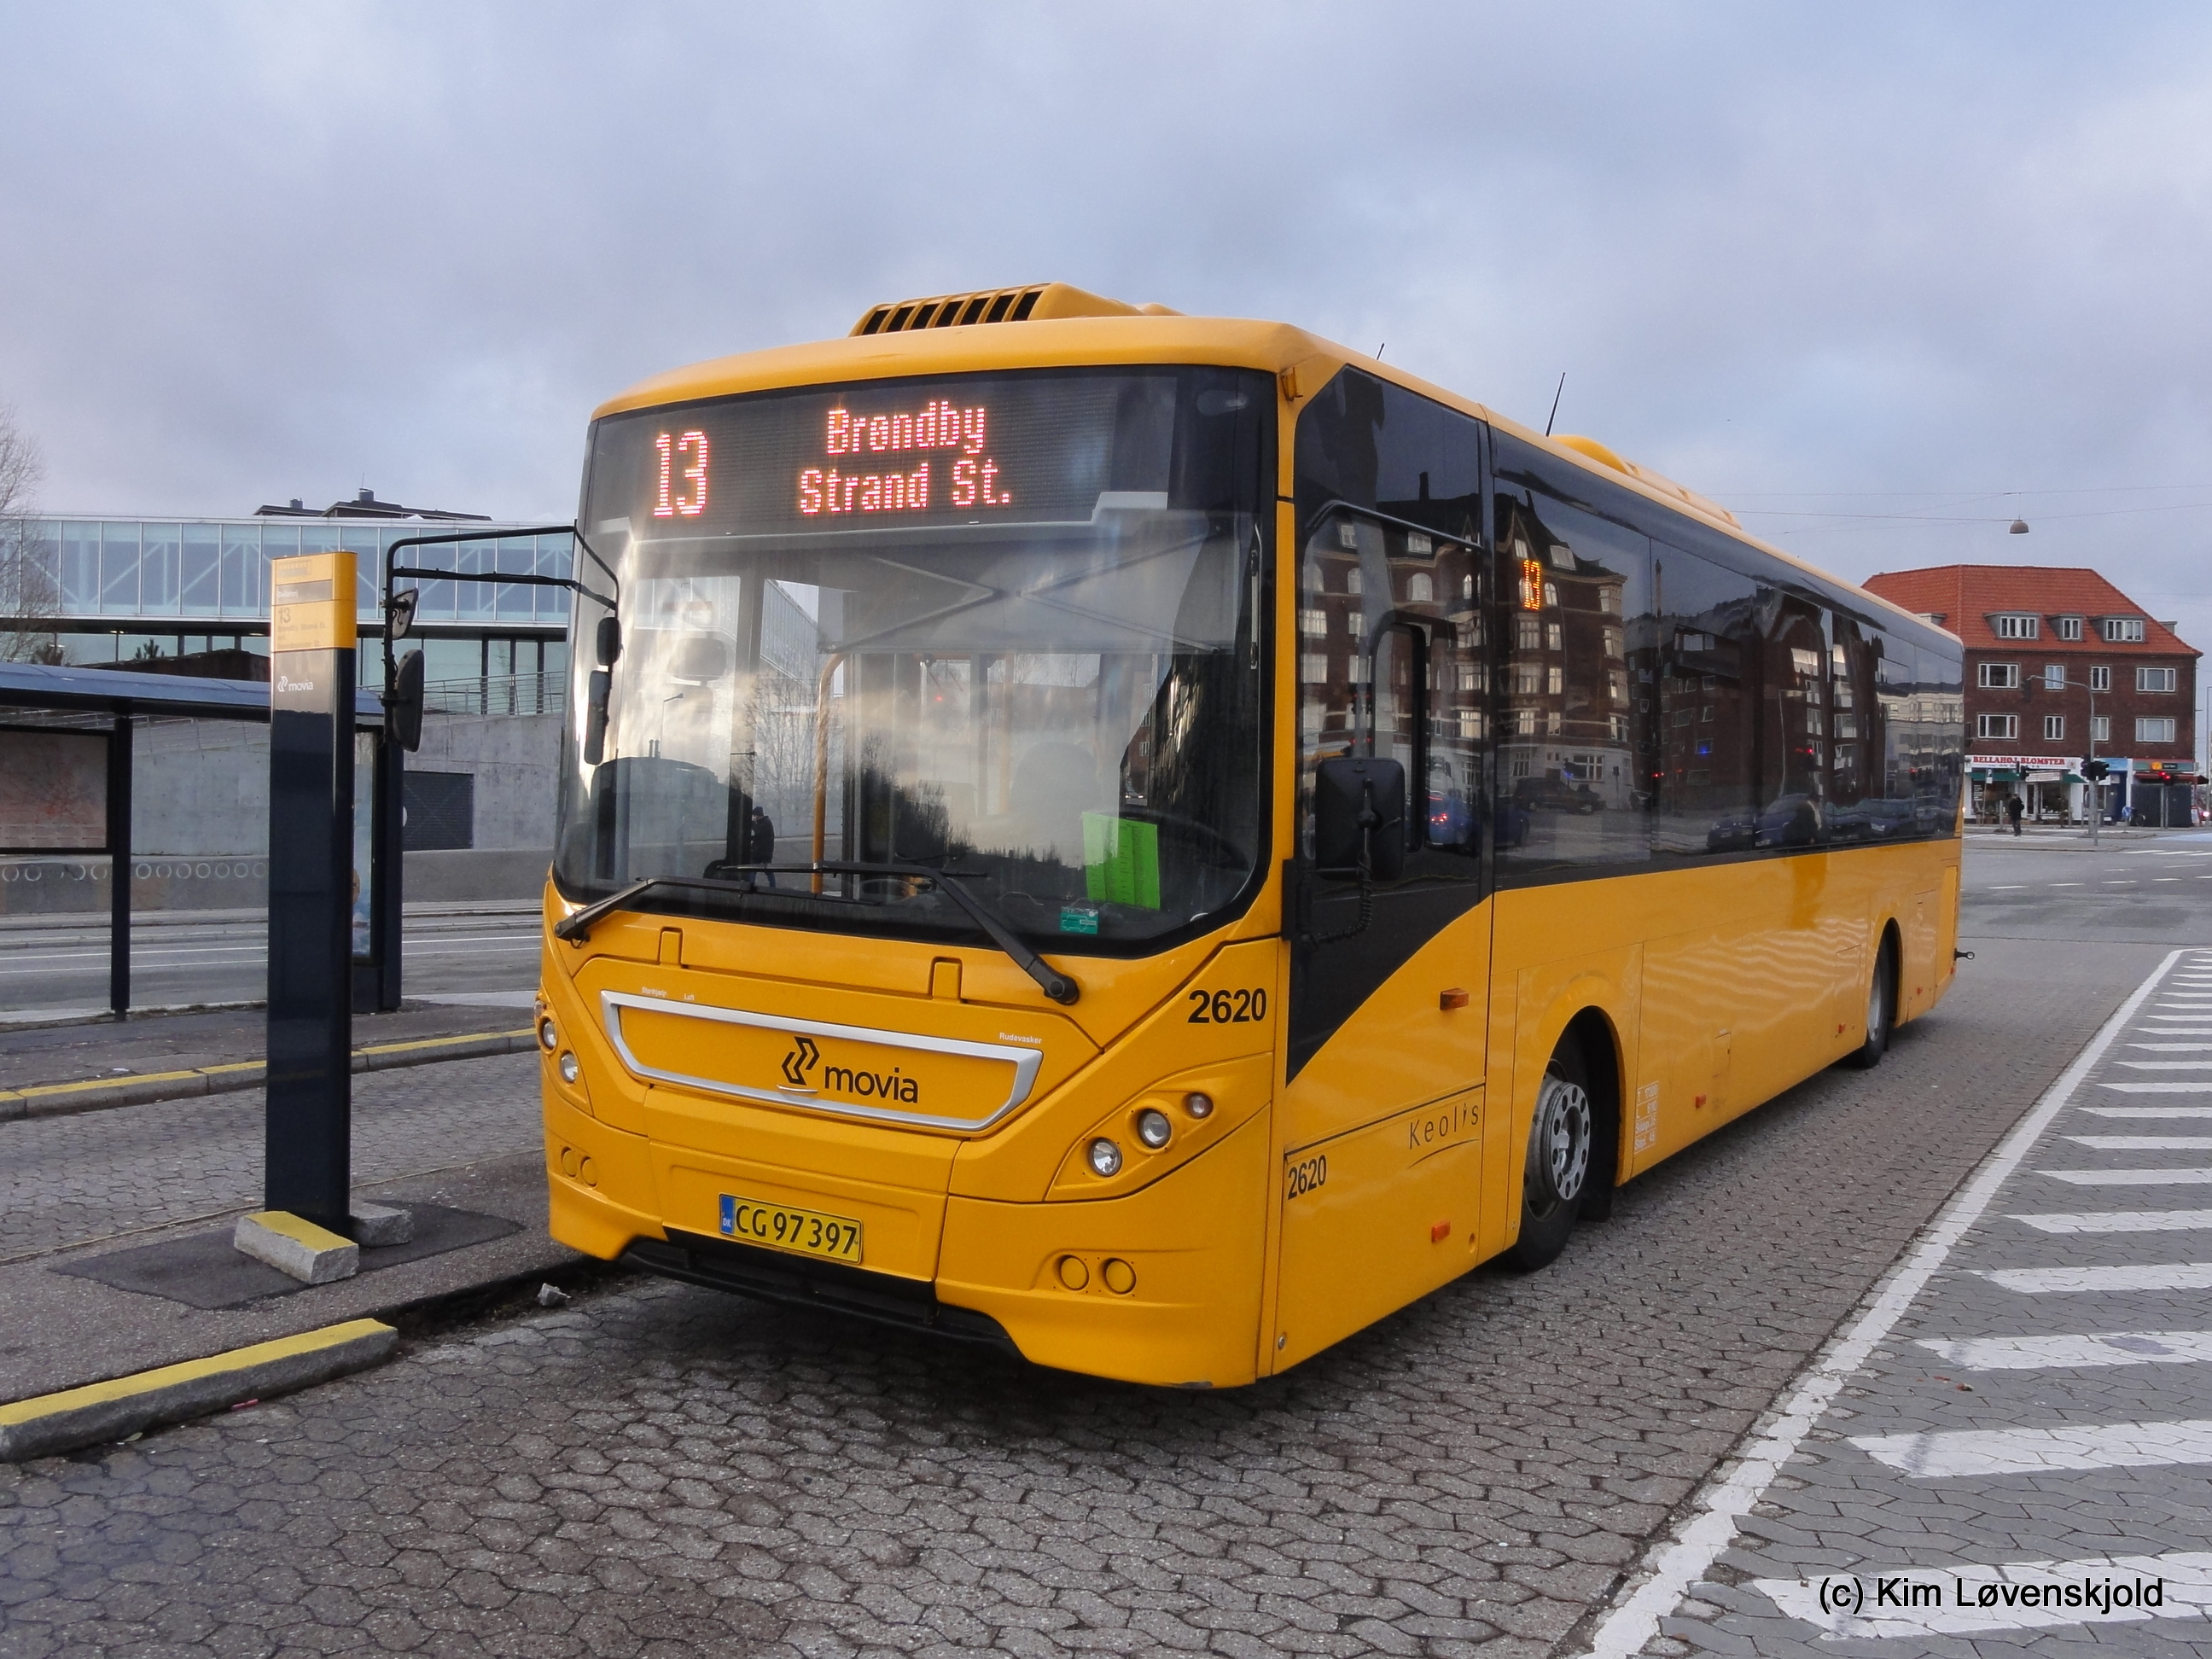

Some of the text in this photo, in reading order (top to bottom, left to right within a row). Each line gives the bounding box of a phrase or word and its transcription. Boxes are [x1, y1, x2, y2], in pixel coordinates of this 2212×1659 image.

[827, 400, 986, 455] Brøndby
[654, 430, 708, 517] 13
[800, 458, 1012, 515] Strand St.
[1523, 559, 1540, 610] 13
[278, 607, 291, 624] 13
[288, 678, 314, 692] movia
[1973, 756, 2065, 765] BELLAHØJ BLOMSTER
[1187, 987, 1267, 1024] 2620
[824, 1065, 918, 1103] movia
[1409, 1102, 1479, 1150] Keolis
[1287, 1154, 1327, 1201] 2620
[722, 1217, 732, 1227] DK
